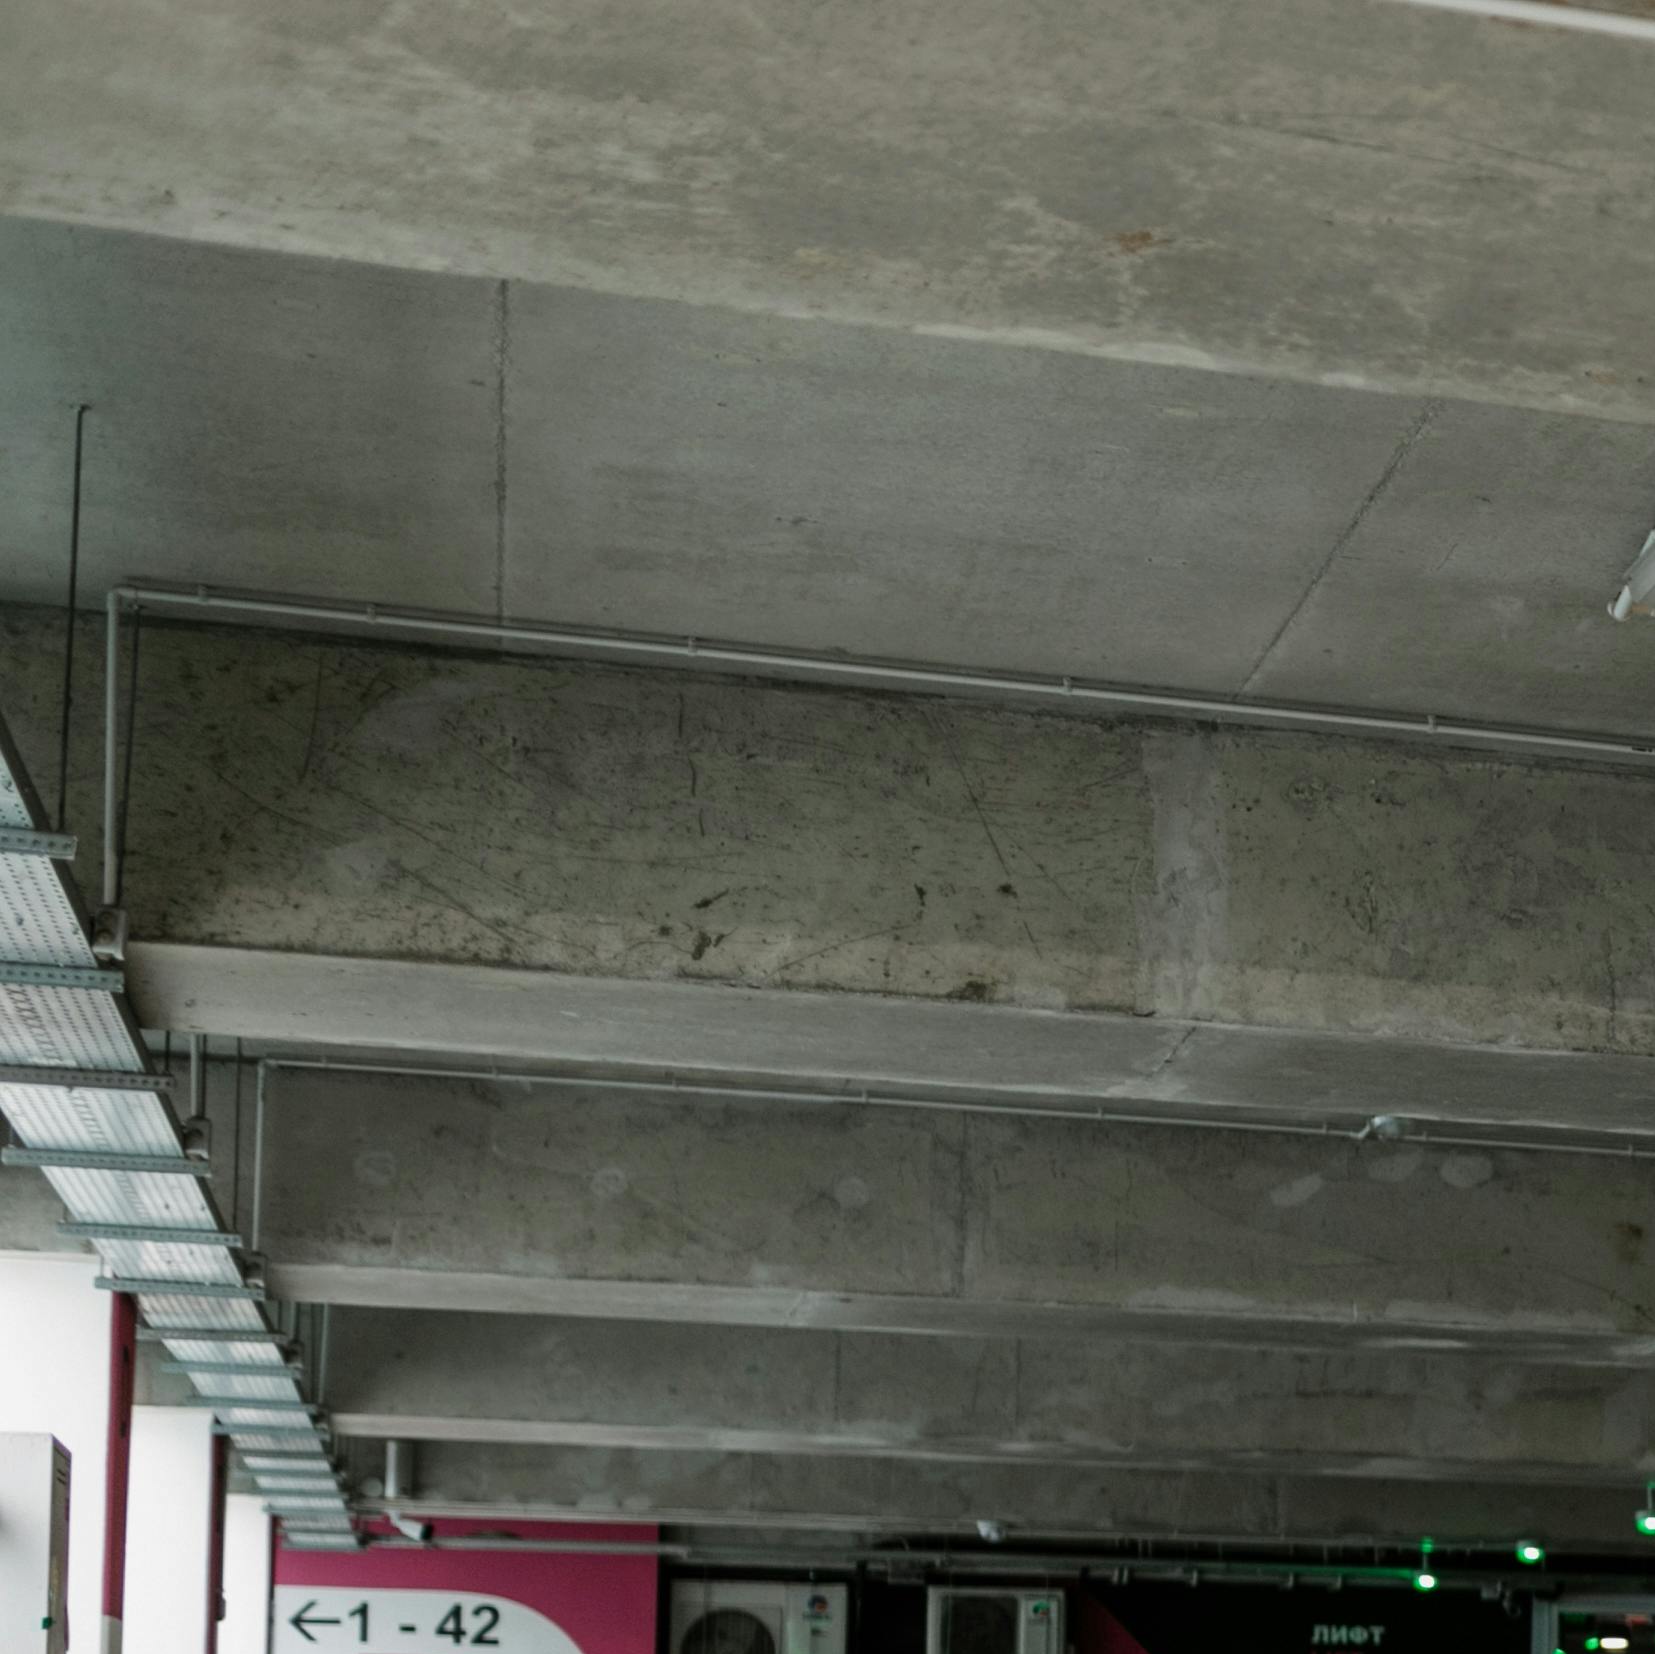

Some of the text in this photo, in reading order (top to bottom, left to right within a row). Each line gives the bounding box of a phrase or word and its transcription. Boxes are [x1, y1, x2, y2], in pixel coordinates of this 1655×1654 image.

[349, 1603, 371, 1643] 1
[434, 1604, 501, 1646] 42
[1311, 1623, 1387, 1646] ЛИФТ
